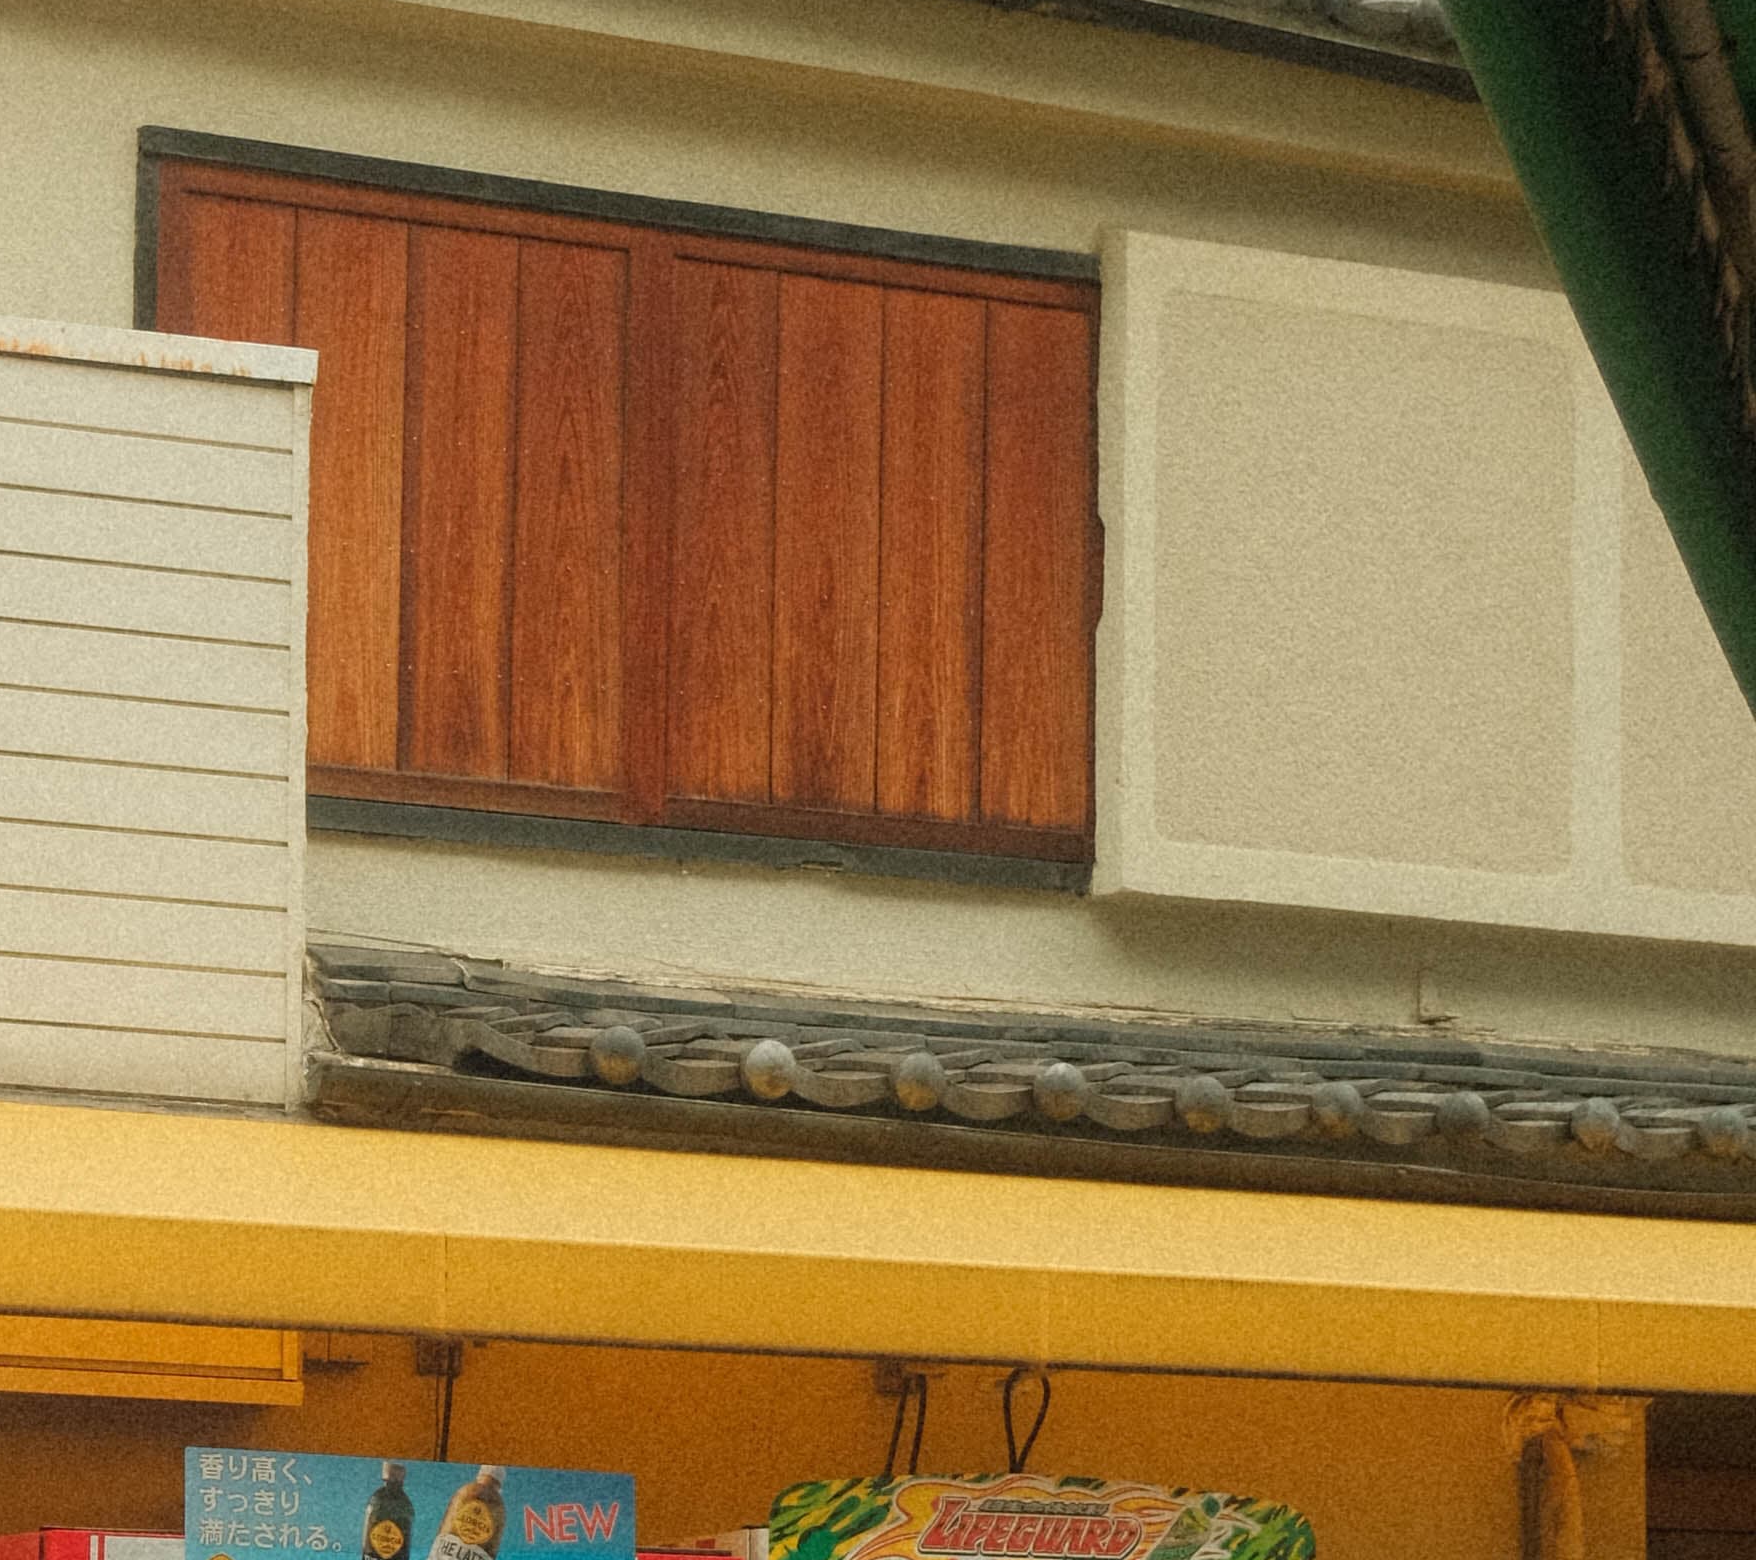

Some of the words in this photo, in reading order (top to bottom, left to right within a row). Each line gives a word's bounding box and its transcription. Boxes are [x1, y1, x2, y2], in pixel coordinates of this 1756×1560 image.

[199, 1452, 312, 1485] 香り高く、
[199, 1486, 299, 1516] すっきり
[199, 1517, 342, 1552] 満たされる。
[523, 1501, 620, 1545] NEW
[920, 1497, 1141, 1557] LIFEGUARD
